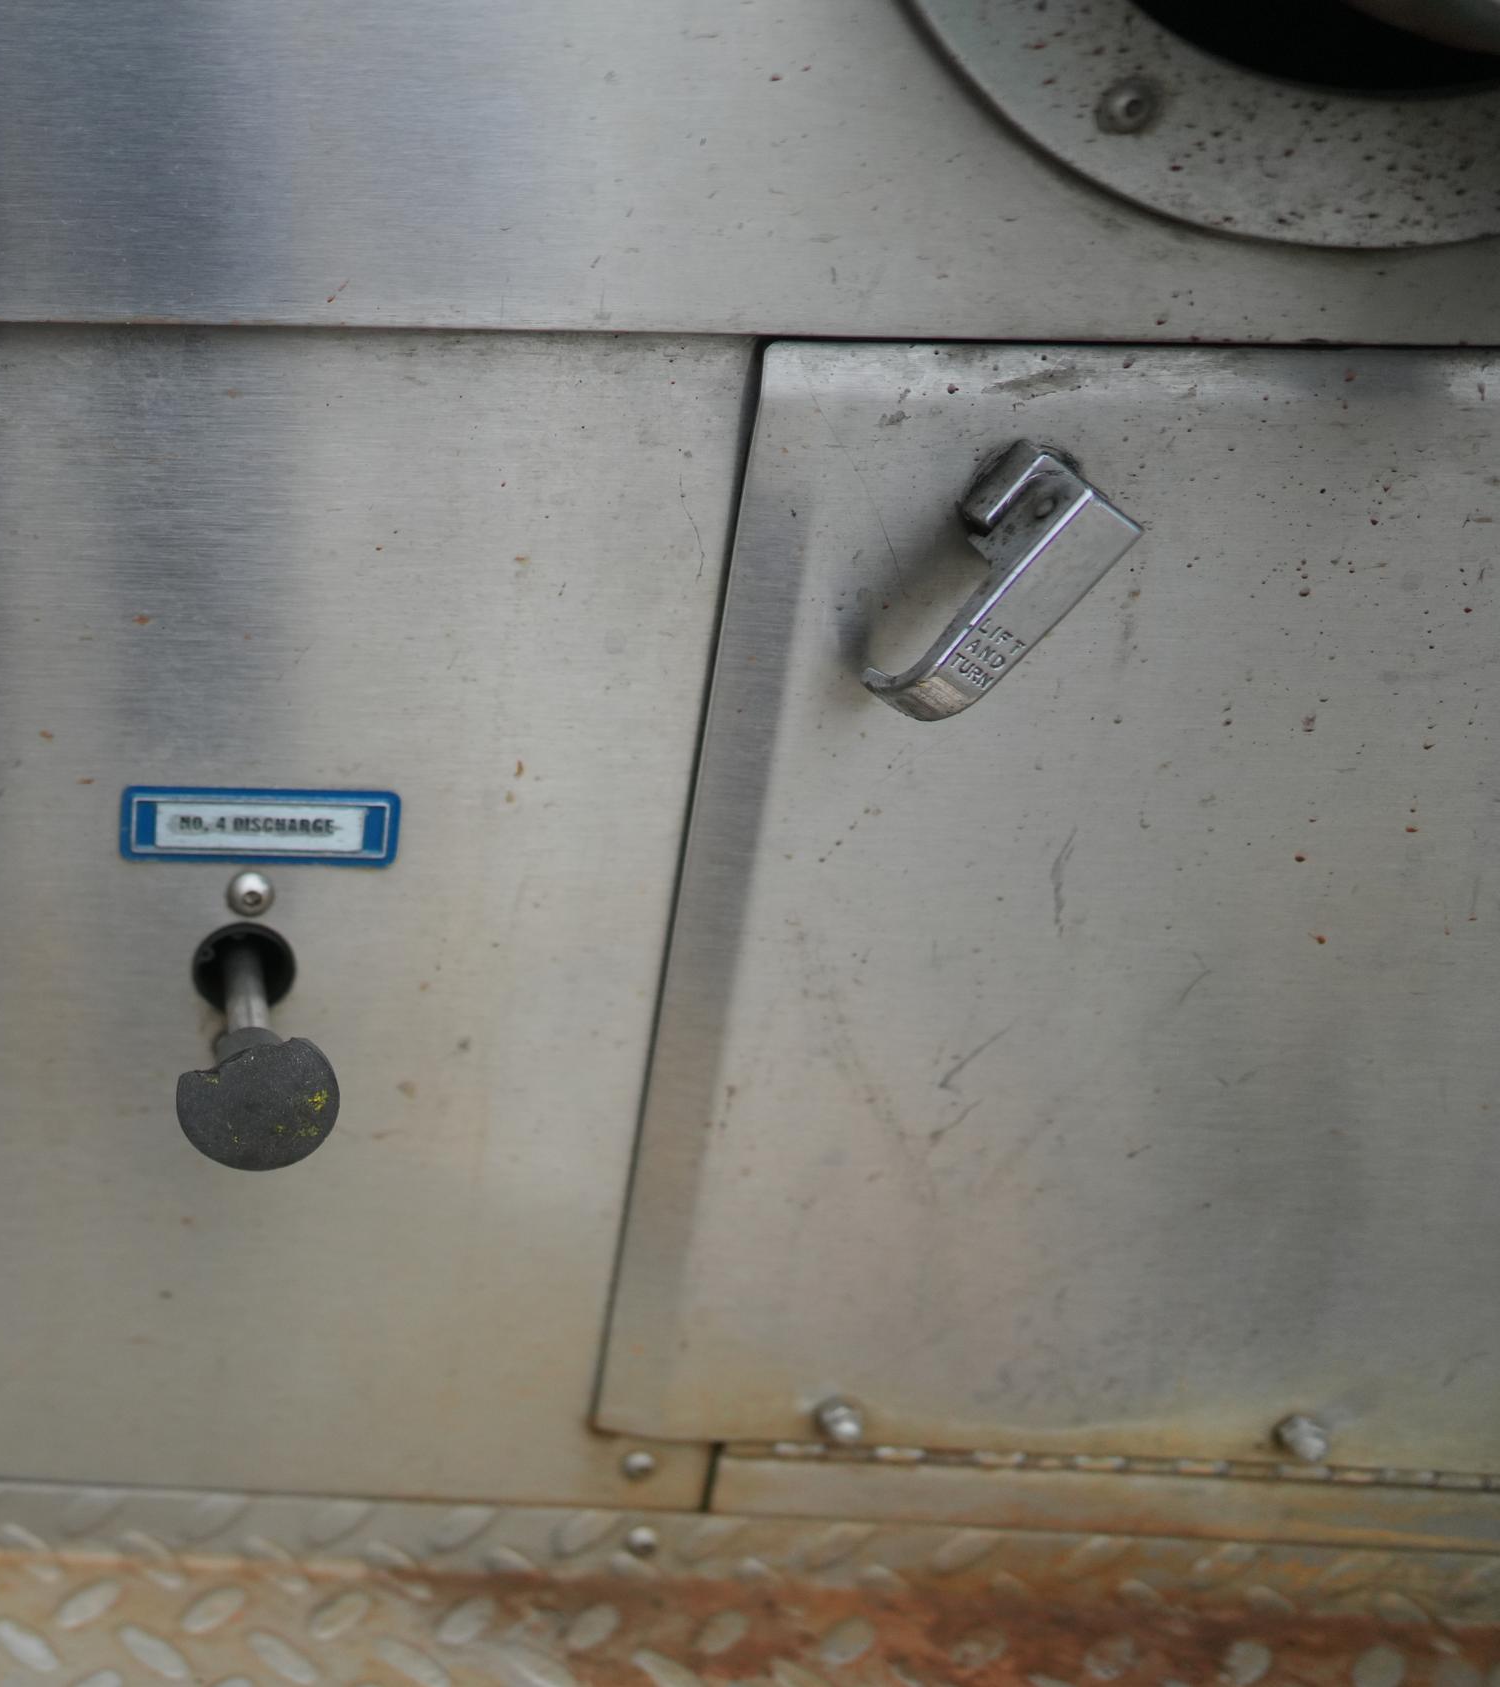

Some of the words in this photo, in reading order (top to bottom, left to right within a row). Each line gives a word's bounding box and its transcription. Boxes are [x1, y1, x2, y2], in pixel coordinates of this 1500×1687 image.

[978, 617, 1026, 655] LIFT
[950, 652, 994, 690] TURN
[964, 639, 1006, 670] AND
[179, 816, 209, 832] NO.
[215, 817, 226, 830] 4
[233, 817, 336, 835] DISCHARGE
